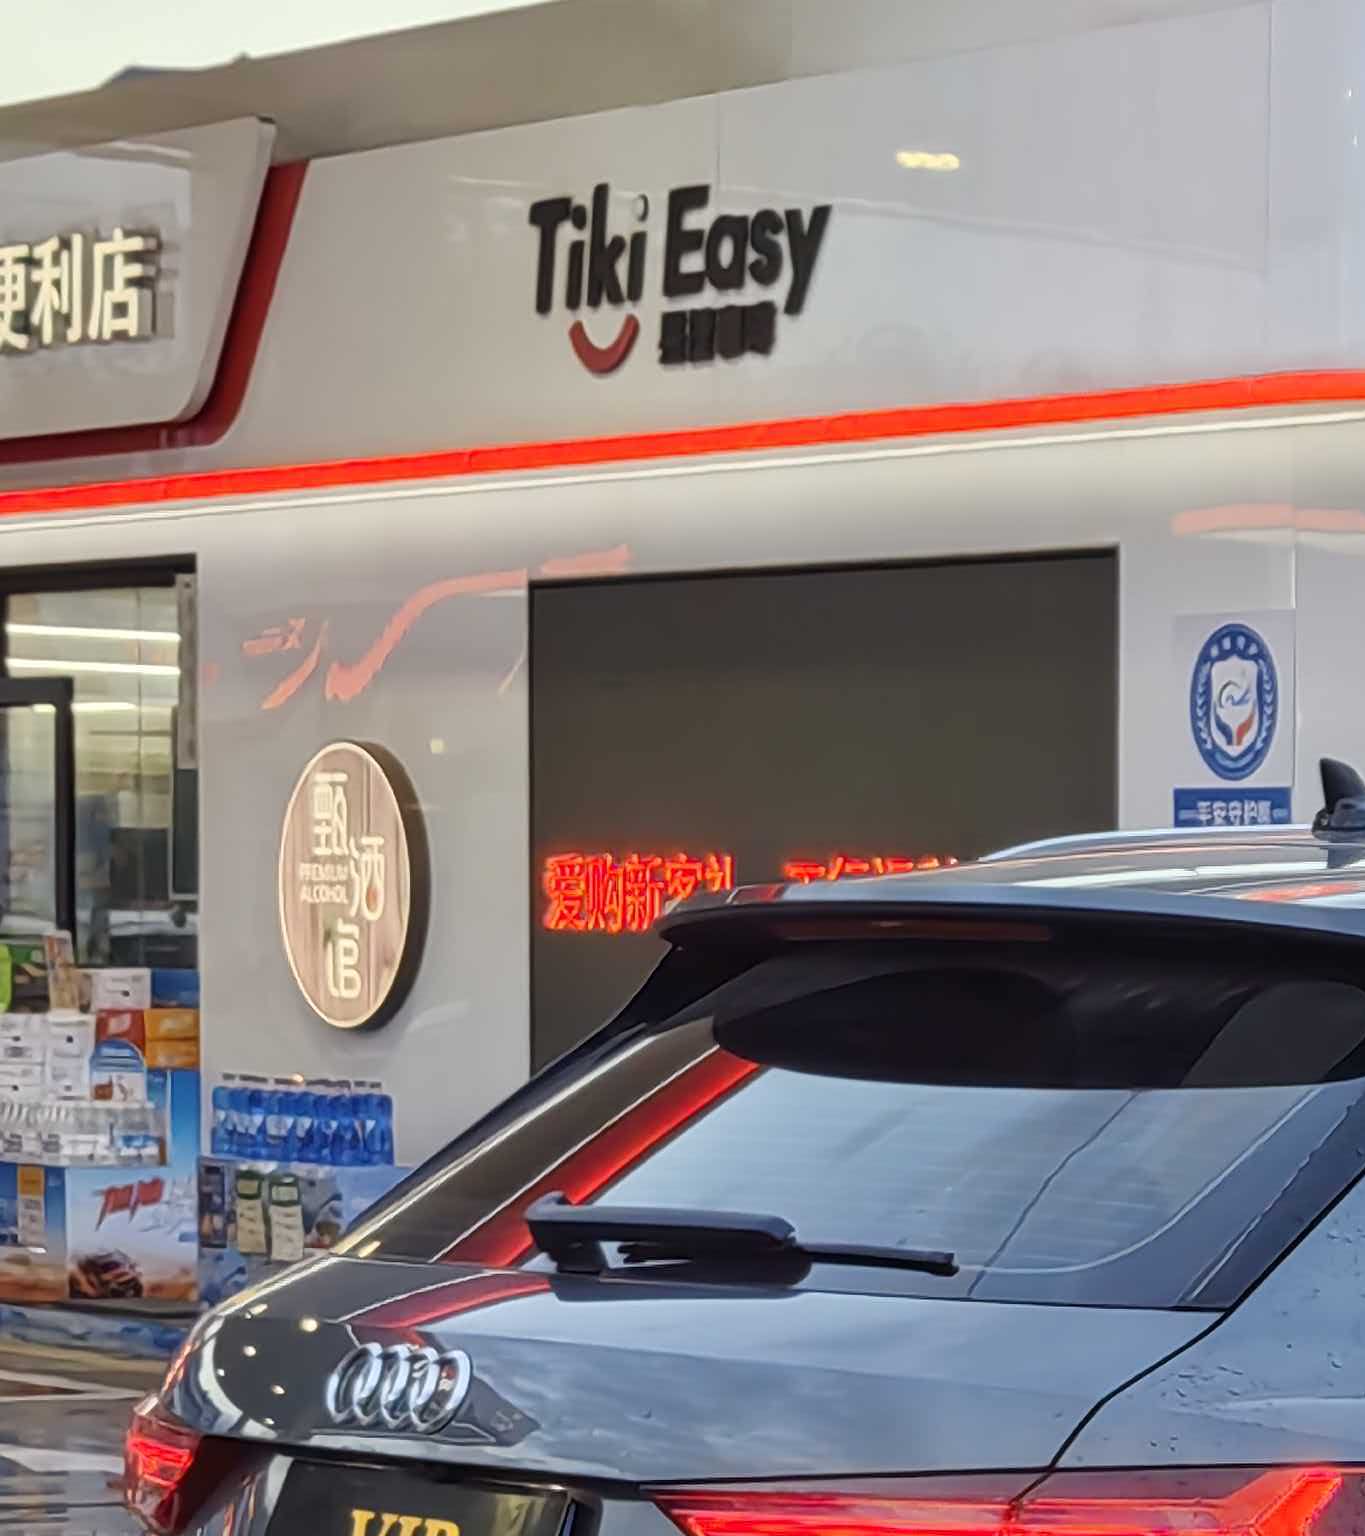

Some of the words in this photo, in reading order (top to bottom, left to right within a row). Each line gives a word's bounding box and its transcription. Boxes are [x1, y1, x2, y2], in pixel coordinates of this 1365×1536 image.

[529, 182, 649, 316] Tiki
[662, 183, 833, 316] Easy
[300, 863, 349, 881] PREMIUM
[300, 884, 350, 904] ALCOHOL
